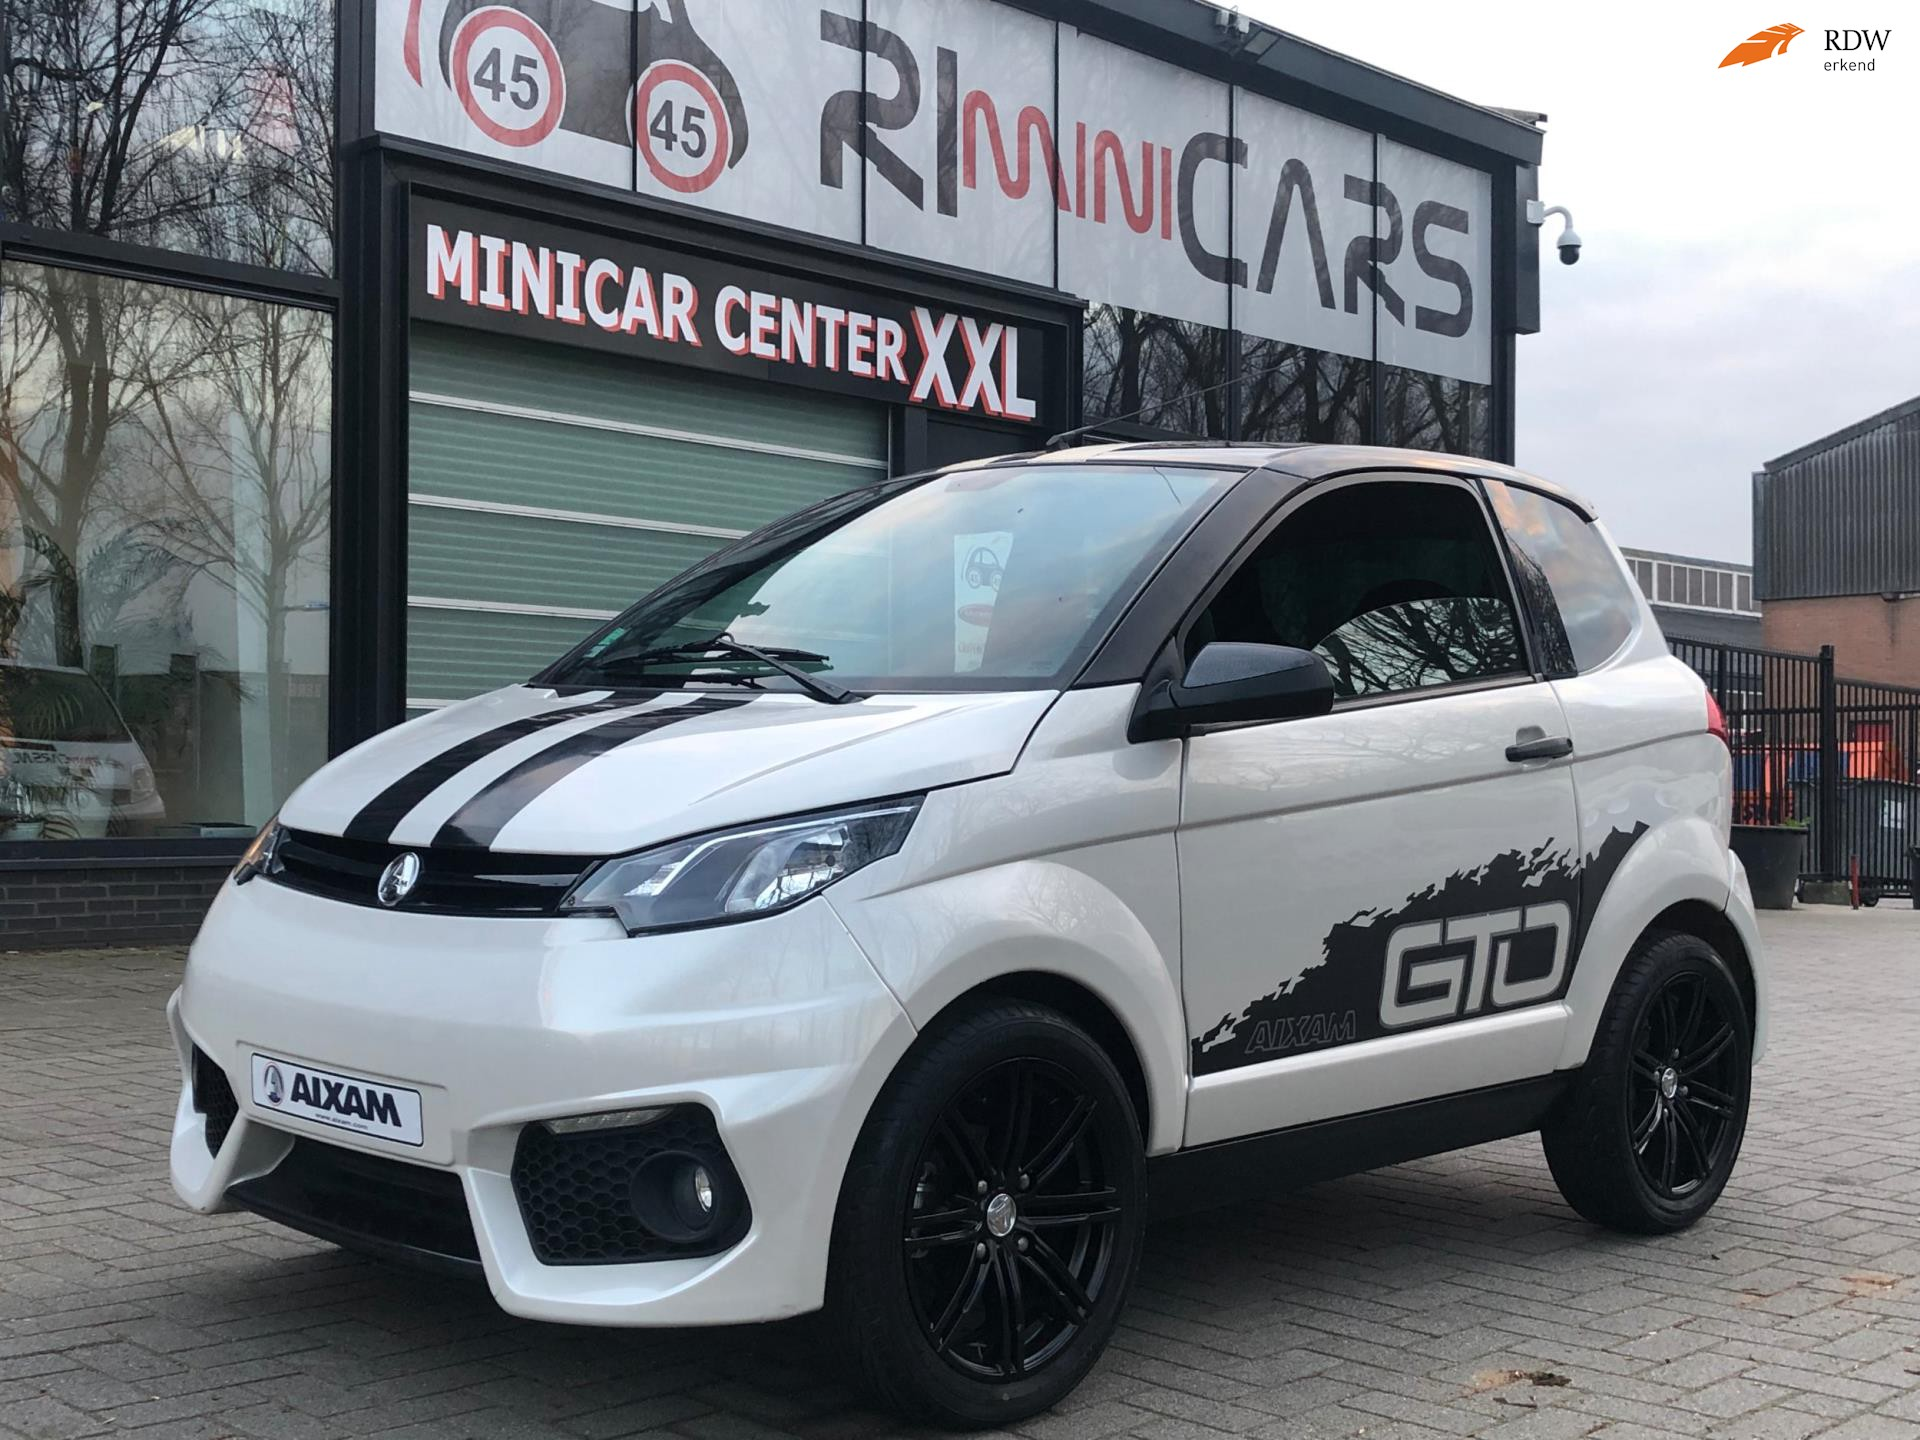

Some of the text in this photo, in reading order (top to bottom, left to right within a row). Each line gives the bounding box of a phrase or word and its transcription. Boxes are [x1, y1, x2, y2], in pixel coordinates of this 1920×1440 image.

[473, 47, 540, 111] 45
[649, 99, 708, 159] 45
[426, 224, 1037, 421] MINICAR CENTER XXL
[1244, 1010, 1357, 1055] AIXAM
[291, 1073, 402, 1127] AIXAM
